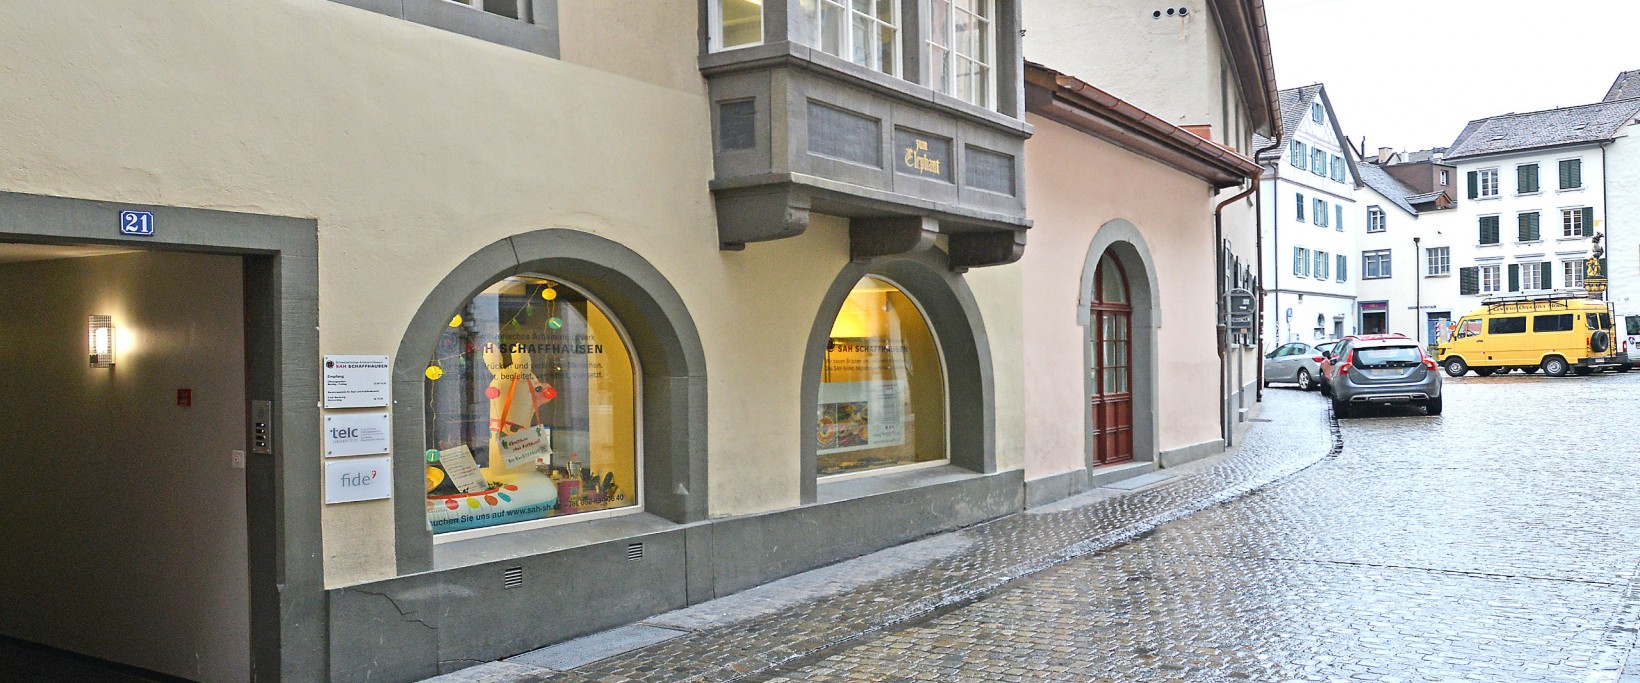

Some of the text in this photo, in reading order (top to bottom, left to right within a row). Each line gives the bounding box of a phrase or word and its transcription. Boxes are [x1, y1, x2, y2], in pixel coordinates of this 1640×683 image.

[915, 139, 929, 152] zum
[904, 148, 941, 174] Elephant
[125, 213, 149, 233] 21
[499, 343, 604, 355] SCHAFFHAUSEN
[837, 345, 853, 353] SAH
[514, 362, 529, 370] und
[500, 372, 534, 382] begleitet,
[331, 427, 358, 439] telc
[460, 514, 475, 523] Sie
[475, 512, 491, 521] uns
[491, 509, 505, 519] auf
[616, 493, 625, 501] 40
